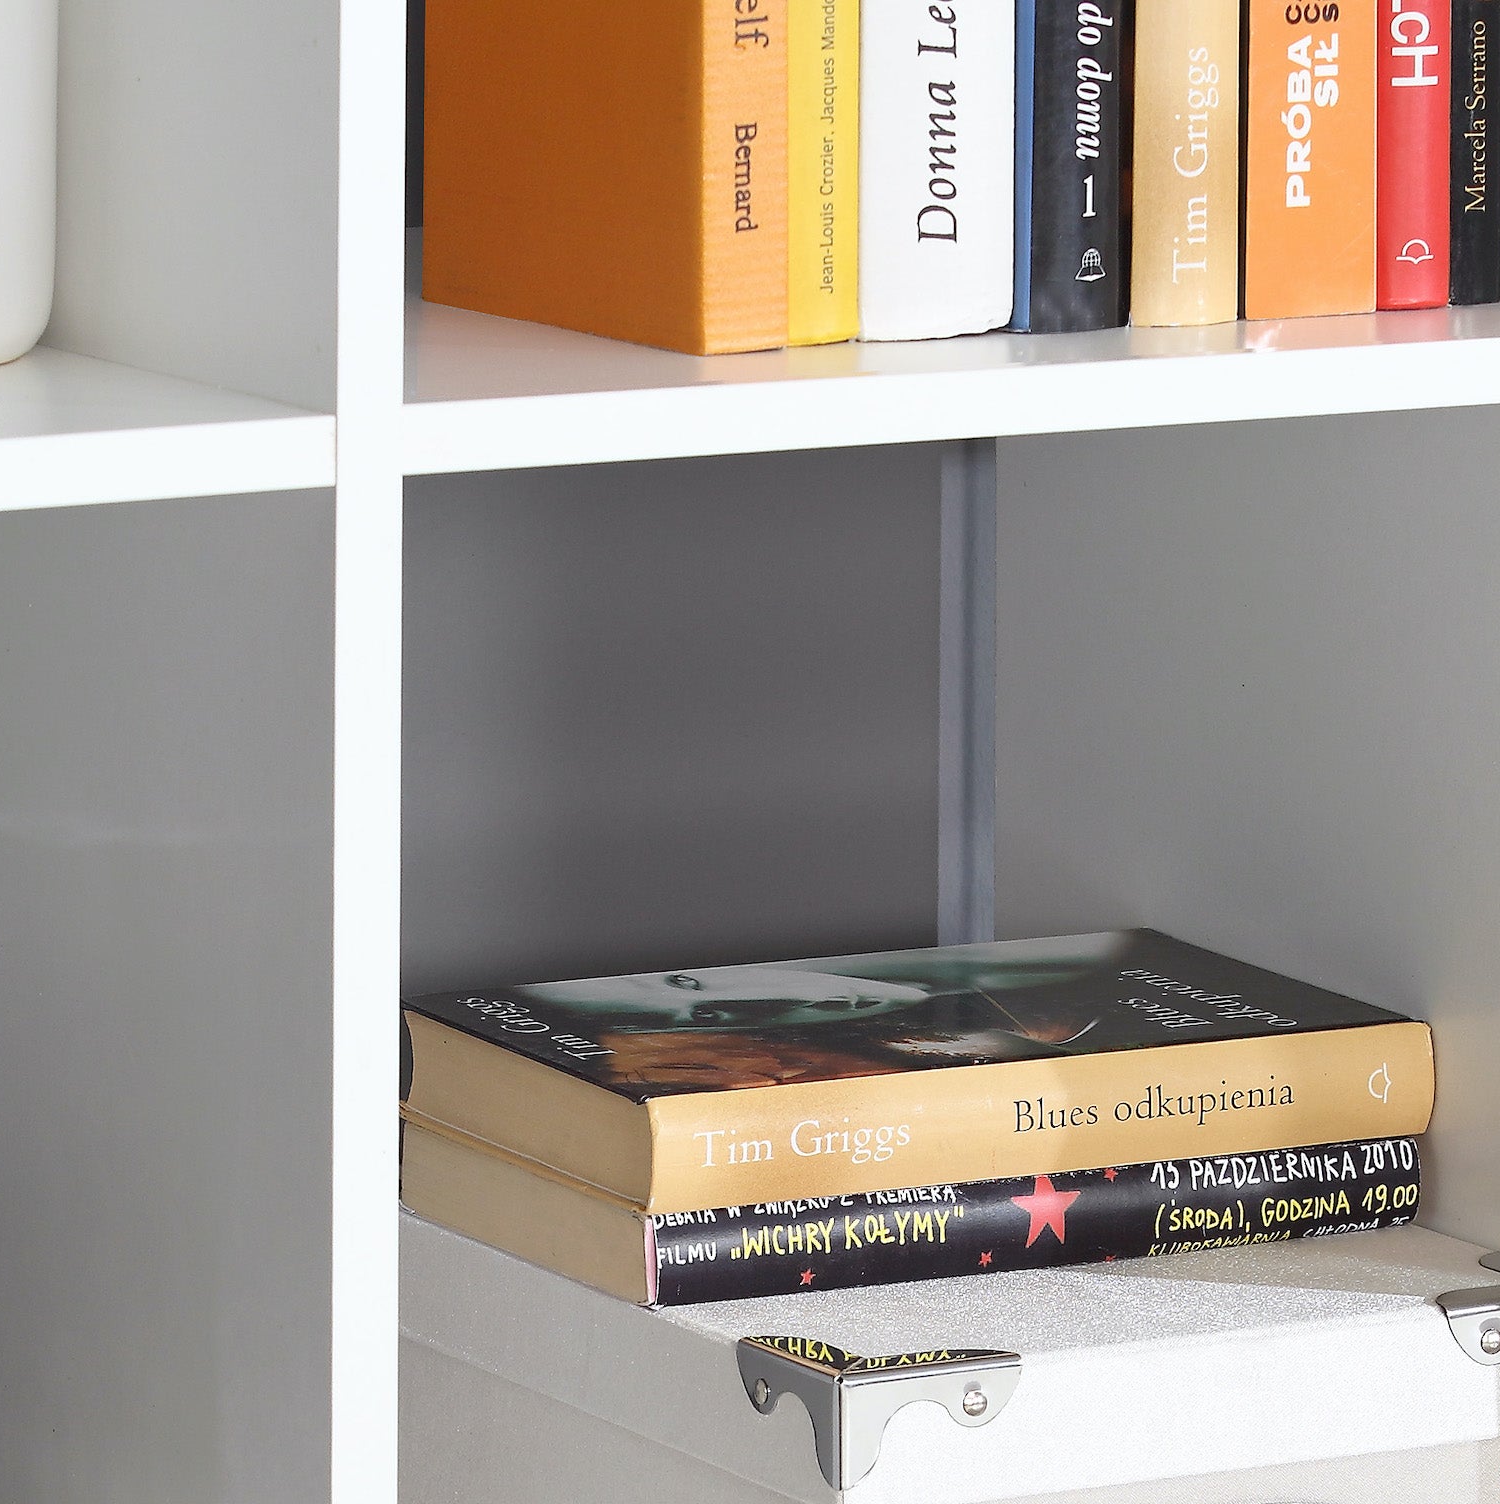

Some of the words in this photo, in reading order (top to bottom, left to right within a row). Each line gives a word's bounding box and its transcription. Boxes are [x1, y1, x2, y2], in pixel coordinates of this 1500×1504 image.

[917, 0, 958, 58] Le
[1076, 1, 1115, 46] do
[821, 58, 838, 124] Jacques
[1464, 19, 1488, 111] Serrano
[1075, 56, 1113, 161] domu
[1172, 46, 1220, 178] Griggs
[1281, 35, 1313, 208] PRÓBA
[1314, 33, 1340, 108] SIŁ
[735, 122, 759, 234] Bernard
[917, 80, 958, 244] Donna
[1464, 119, 1487, 213] Marcela
[1082, 174, 1098, 219] 1
[820, 202, 834, 294] Jean-Louis
[1172, 194, 1209, 285] Tim
[456, 996, 551, 1034] Griggs
[1116, 967, 1298, 1028] odkupienia
[1116, 996, 1215, 1029] Blues
[551, 1033, 619, 1061] Tim
[1013, 1094, 1100, 1134] Blues
[1114, 1075, 1296, 1129] odkupienia
[694, 1129, 775, 1169] Tim
[791, 1117, 912, 1164] Griggs
[1361, 1140, 1415, 1175] 2010
[1261, 1189, 1351, 1228] GODZINA
[1361, 1183, 1418, 1214] 19.00
[656, 1242, 718, 1269] FILMU
